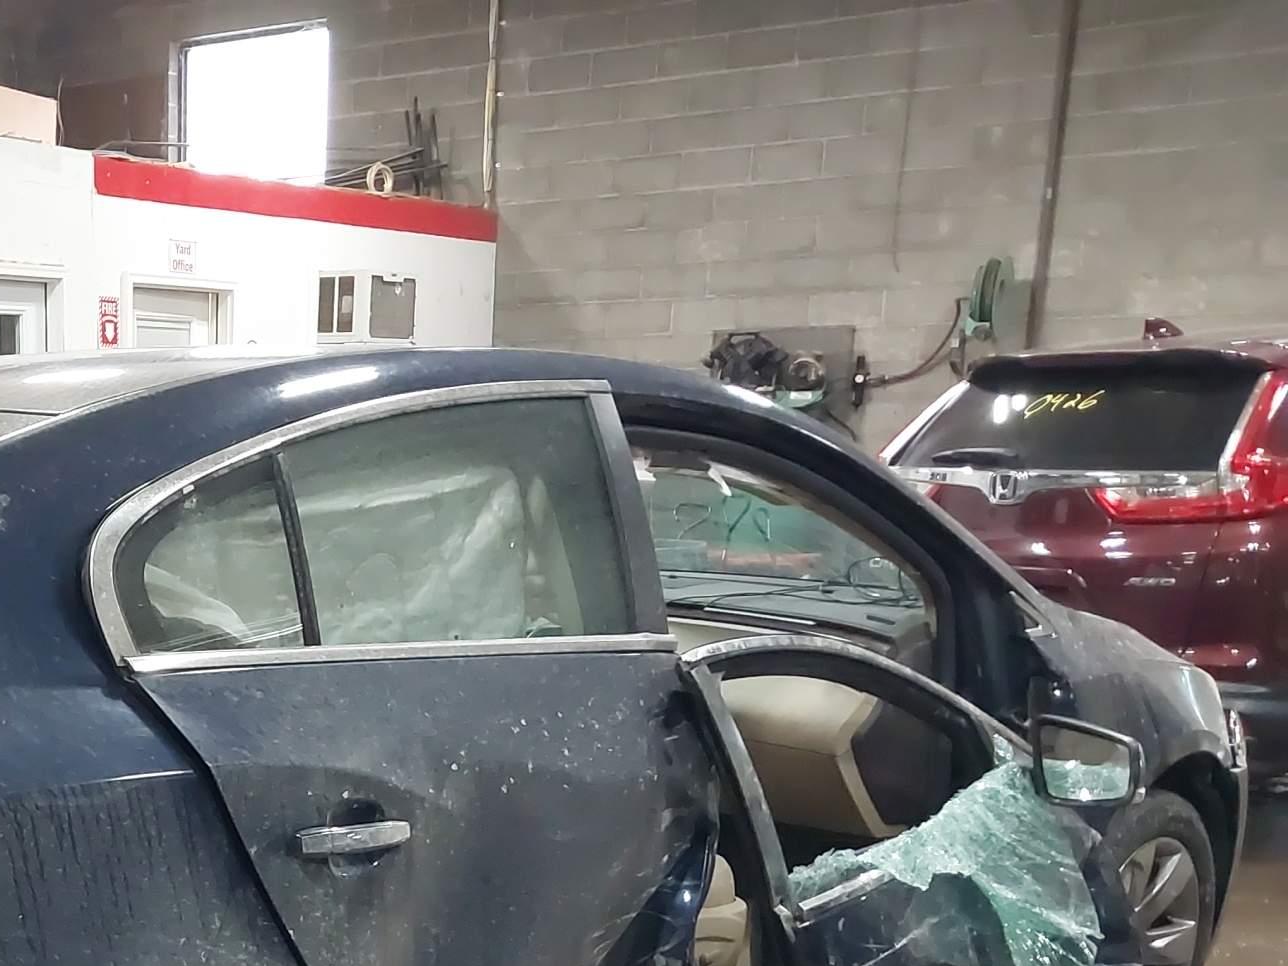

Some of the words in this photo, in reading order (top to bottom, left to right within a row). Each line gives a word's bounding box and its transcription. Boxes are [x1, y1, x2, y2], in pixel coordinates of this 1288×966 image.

[175, 242, 192, 256] Yard
[172, 259, 193, 273] Office
[101, 302, 117, 315] FIRE
[1023, 390, 1106, 420] 0426
